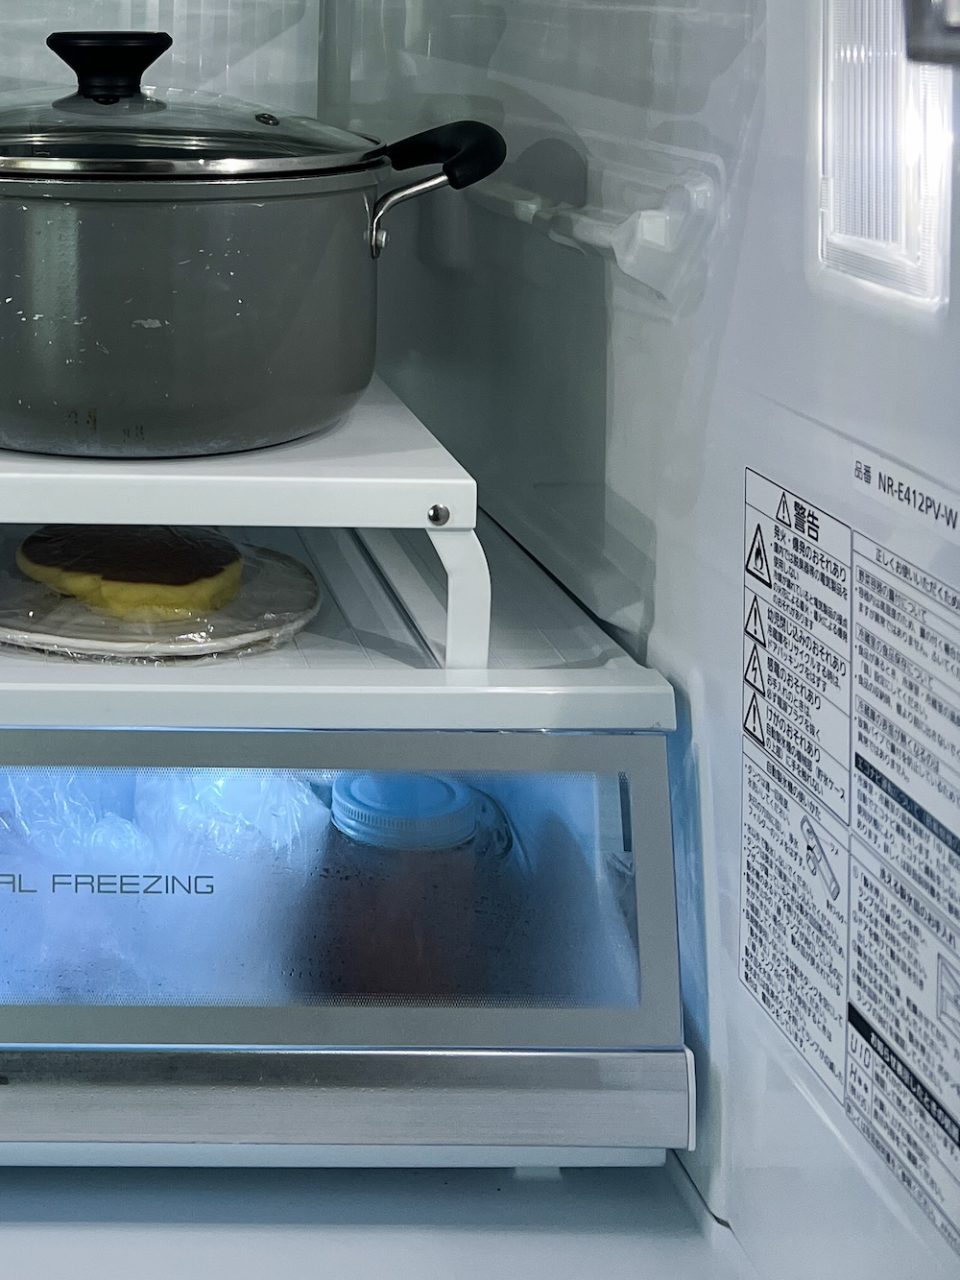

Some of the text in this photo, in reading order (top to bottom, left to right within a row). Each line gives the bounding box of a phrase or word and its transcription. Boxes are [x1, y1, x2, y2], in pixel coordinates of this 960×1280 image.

[854, 460, 958, 530] 品番 NR-E412PV-W
[793, 500, 819, 543] 警告
[51, 874, 215, 895] FREEZING
